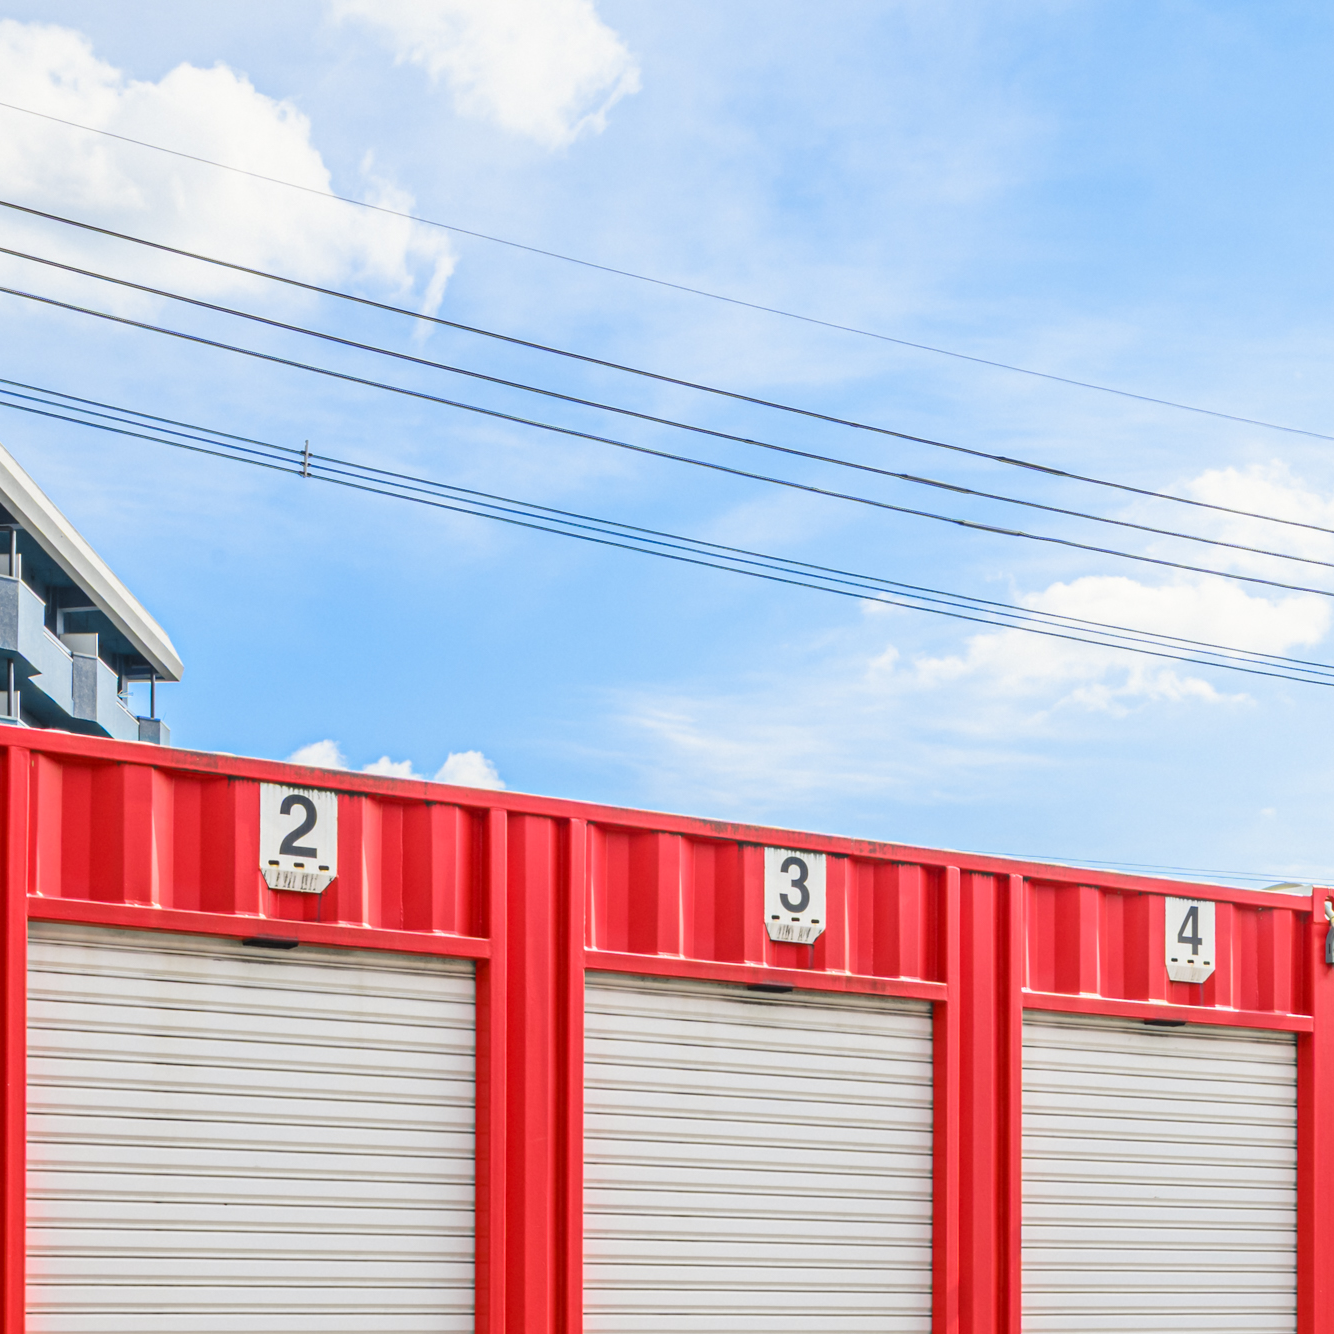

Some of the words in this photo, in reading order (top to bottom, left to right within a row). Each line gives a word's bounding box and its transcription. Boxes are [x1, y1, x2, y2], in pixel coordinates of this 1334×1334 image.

[279, 794, 318, 859] 2
[779, 856, 810, 914] 3
[1177, 905, 1203, 956] 4
